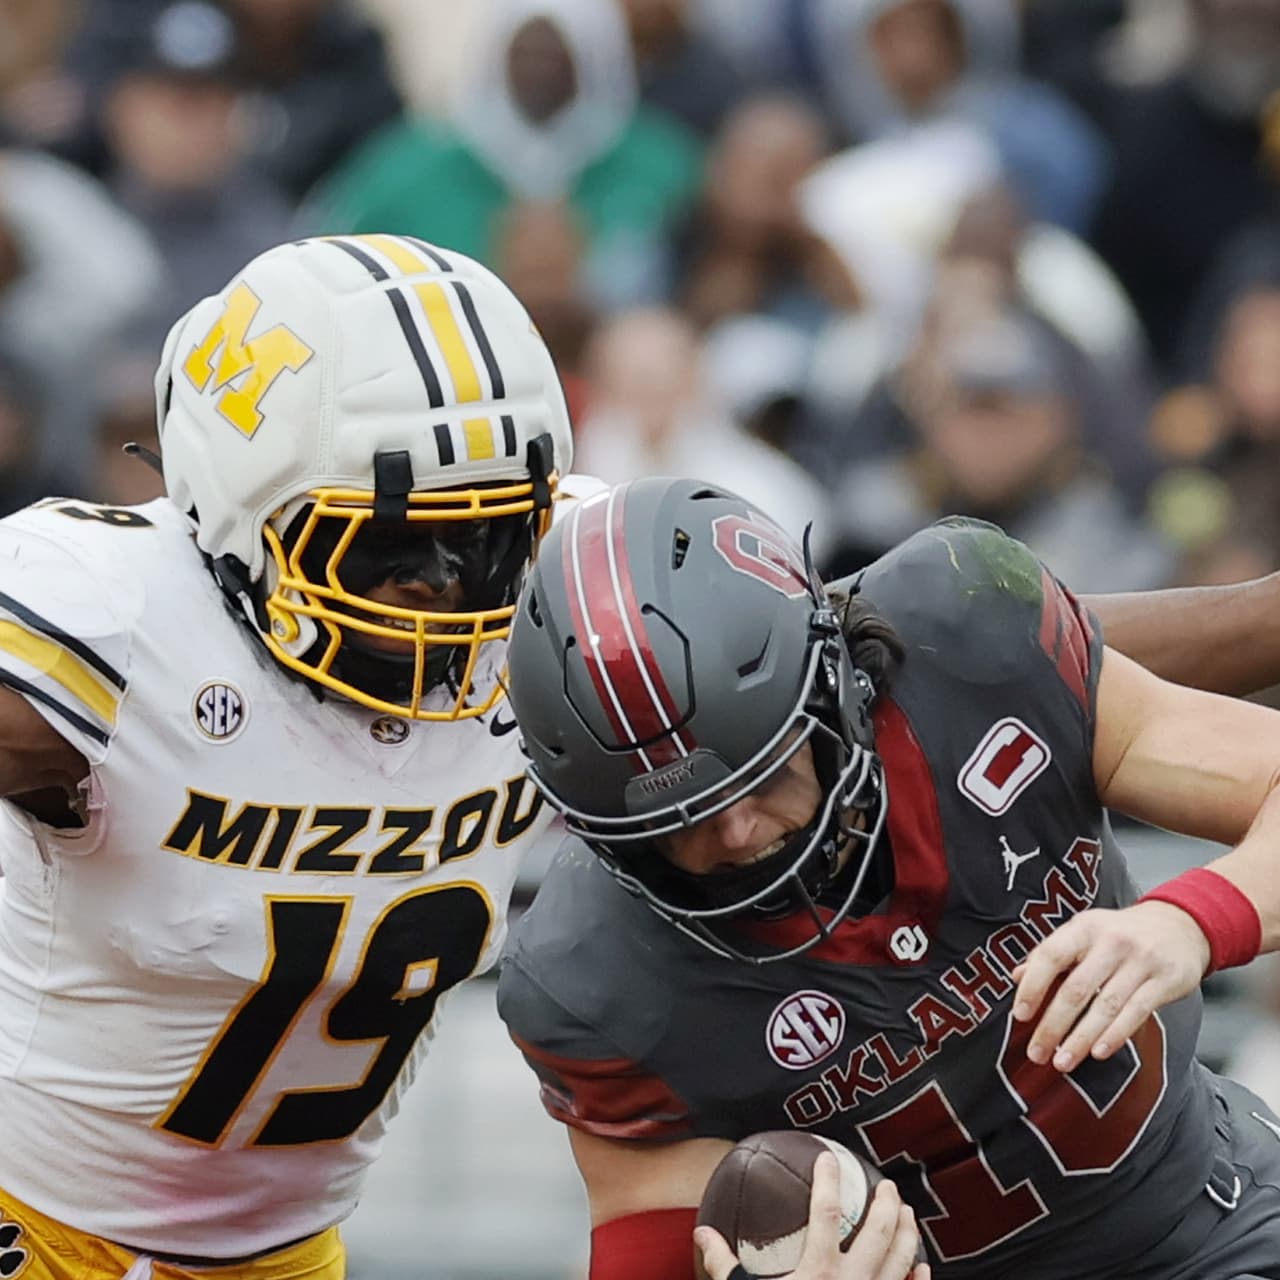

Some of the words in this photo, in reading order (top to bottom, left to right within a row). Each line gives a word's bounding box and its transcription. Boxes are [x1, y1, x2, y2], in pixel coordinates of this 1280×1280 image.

[182, 279, 316, 441] M
[197, 685, 241, 736] SEC
[641, 761, 695, 795] UNITY
[964, 724, 1045, 811] C
[161, 773, 546, 877] MIZZOU
[153, 880, 494, 1150] 19
[772, 997, 839, 1063] SEC
[783, 837, 1103, 1128] OKLAHOMA
[855, 985, 1168, 1263] 10
